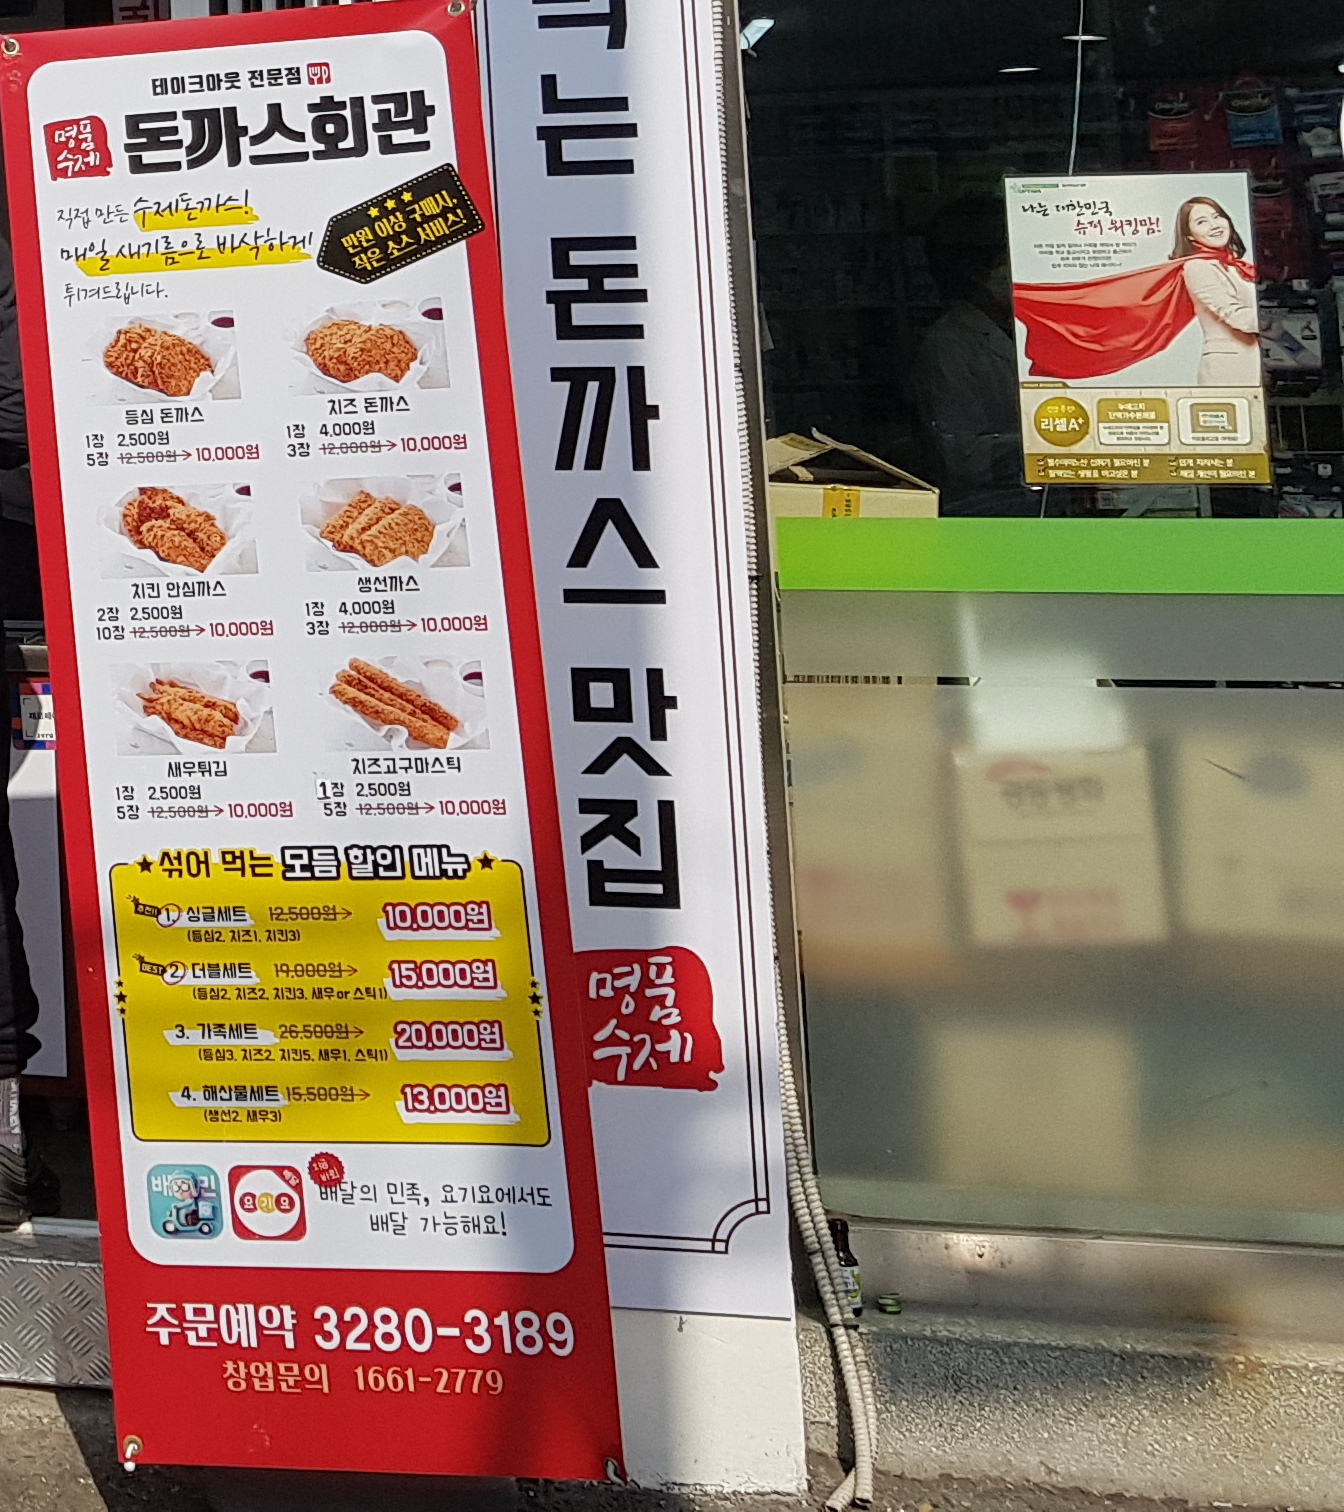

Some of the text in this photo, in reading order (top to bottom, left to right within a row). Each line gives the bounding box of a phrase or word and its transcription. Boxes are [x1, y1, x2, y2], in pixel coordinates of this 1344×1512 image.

[151, 64, 302, 98] 테이크아웃 전문점
[53, 118, 96, 151] 명품
[123, 90, 437, 176] 돈까스회관
[56, 148, 101, 178] 수제
[56, 200, 91, 231] 직접
[95, 201, 130, 226] 만든
[1053, 199, 1113, 217] 대한민국
[340, 226, 377, 254] 만원
[374, 211, 407, 238] 이상
[387, 234, 419, 259] 소스
[416, 208, 468, 245] 서비스!
[59, 237, 112, 272] 매일
[216, 228, 314, 262] 바삭하게
[63, 281, 169, 308] 튀겨드립니다.
[327, 395, 412, 416] 치즈 돈까스
[124, 406, 205, 426] 등심 돈까스
[545, 235, 667, 605] 돈까스
[85, 432, 105, 449] 1장
[285, 423, 306, 439] 1장
[86, 450, 109, 467] 5장
[286, 441, 311, 458] 3장
[130, 580, 227, 599] 치킨 안심까스
[357, 575, 421, 593] 생선까스
[96, 606, 120, 622] 2장
[304, 601, 325, 617] 1장
[96, 624, 125, 641] 10장
[305, 620, 330, 636] 3장
[167, 760, 228, 778] 새우튀김
[350, 756, 462, 775] 치즈고구마스틱
[115, 785, 135, 801] 1장
[317, 781, 345, 800] 1장
[569, 666, 682, 910] 맛집
[116, 804, 140, 820] 5장
[323, 801, 348, 817] 5장
[158, 844, 472, 881] 섞어 먹는 모듬 할인 메뉴
[185, 905, 248, 923] 싱글세트
[191, 961, 254, 979] 더블세트
[588, 955, 679, 1026] 명품
[198, 1022, 260, 1040] 가족세트
[592, 1019, 695, 1083] 수제
[202, 1084, 281, 1104] 해산물세트
[319, 1180, 553, 1208] 배달의 민족, 요기요에서도
[368, 1212, 509, 1237] 배달 가능해요!
[144, 1300, 575, 1358] 주문예약 3280-3189
[222, 1360, 505, 1397] 창업문의 1661-2779
